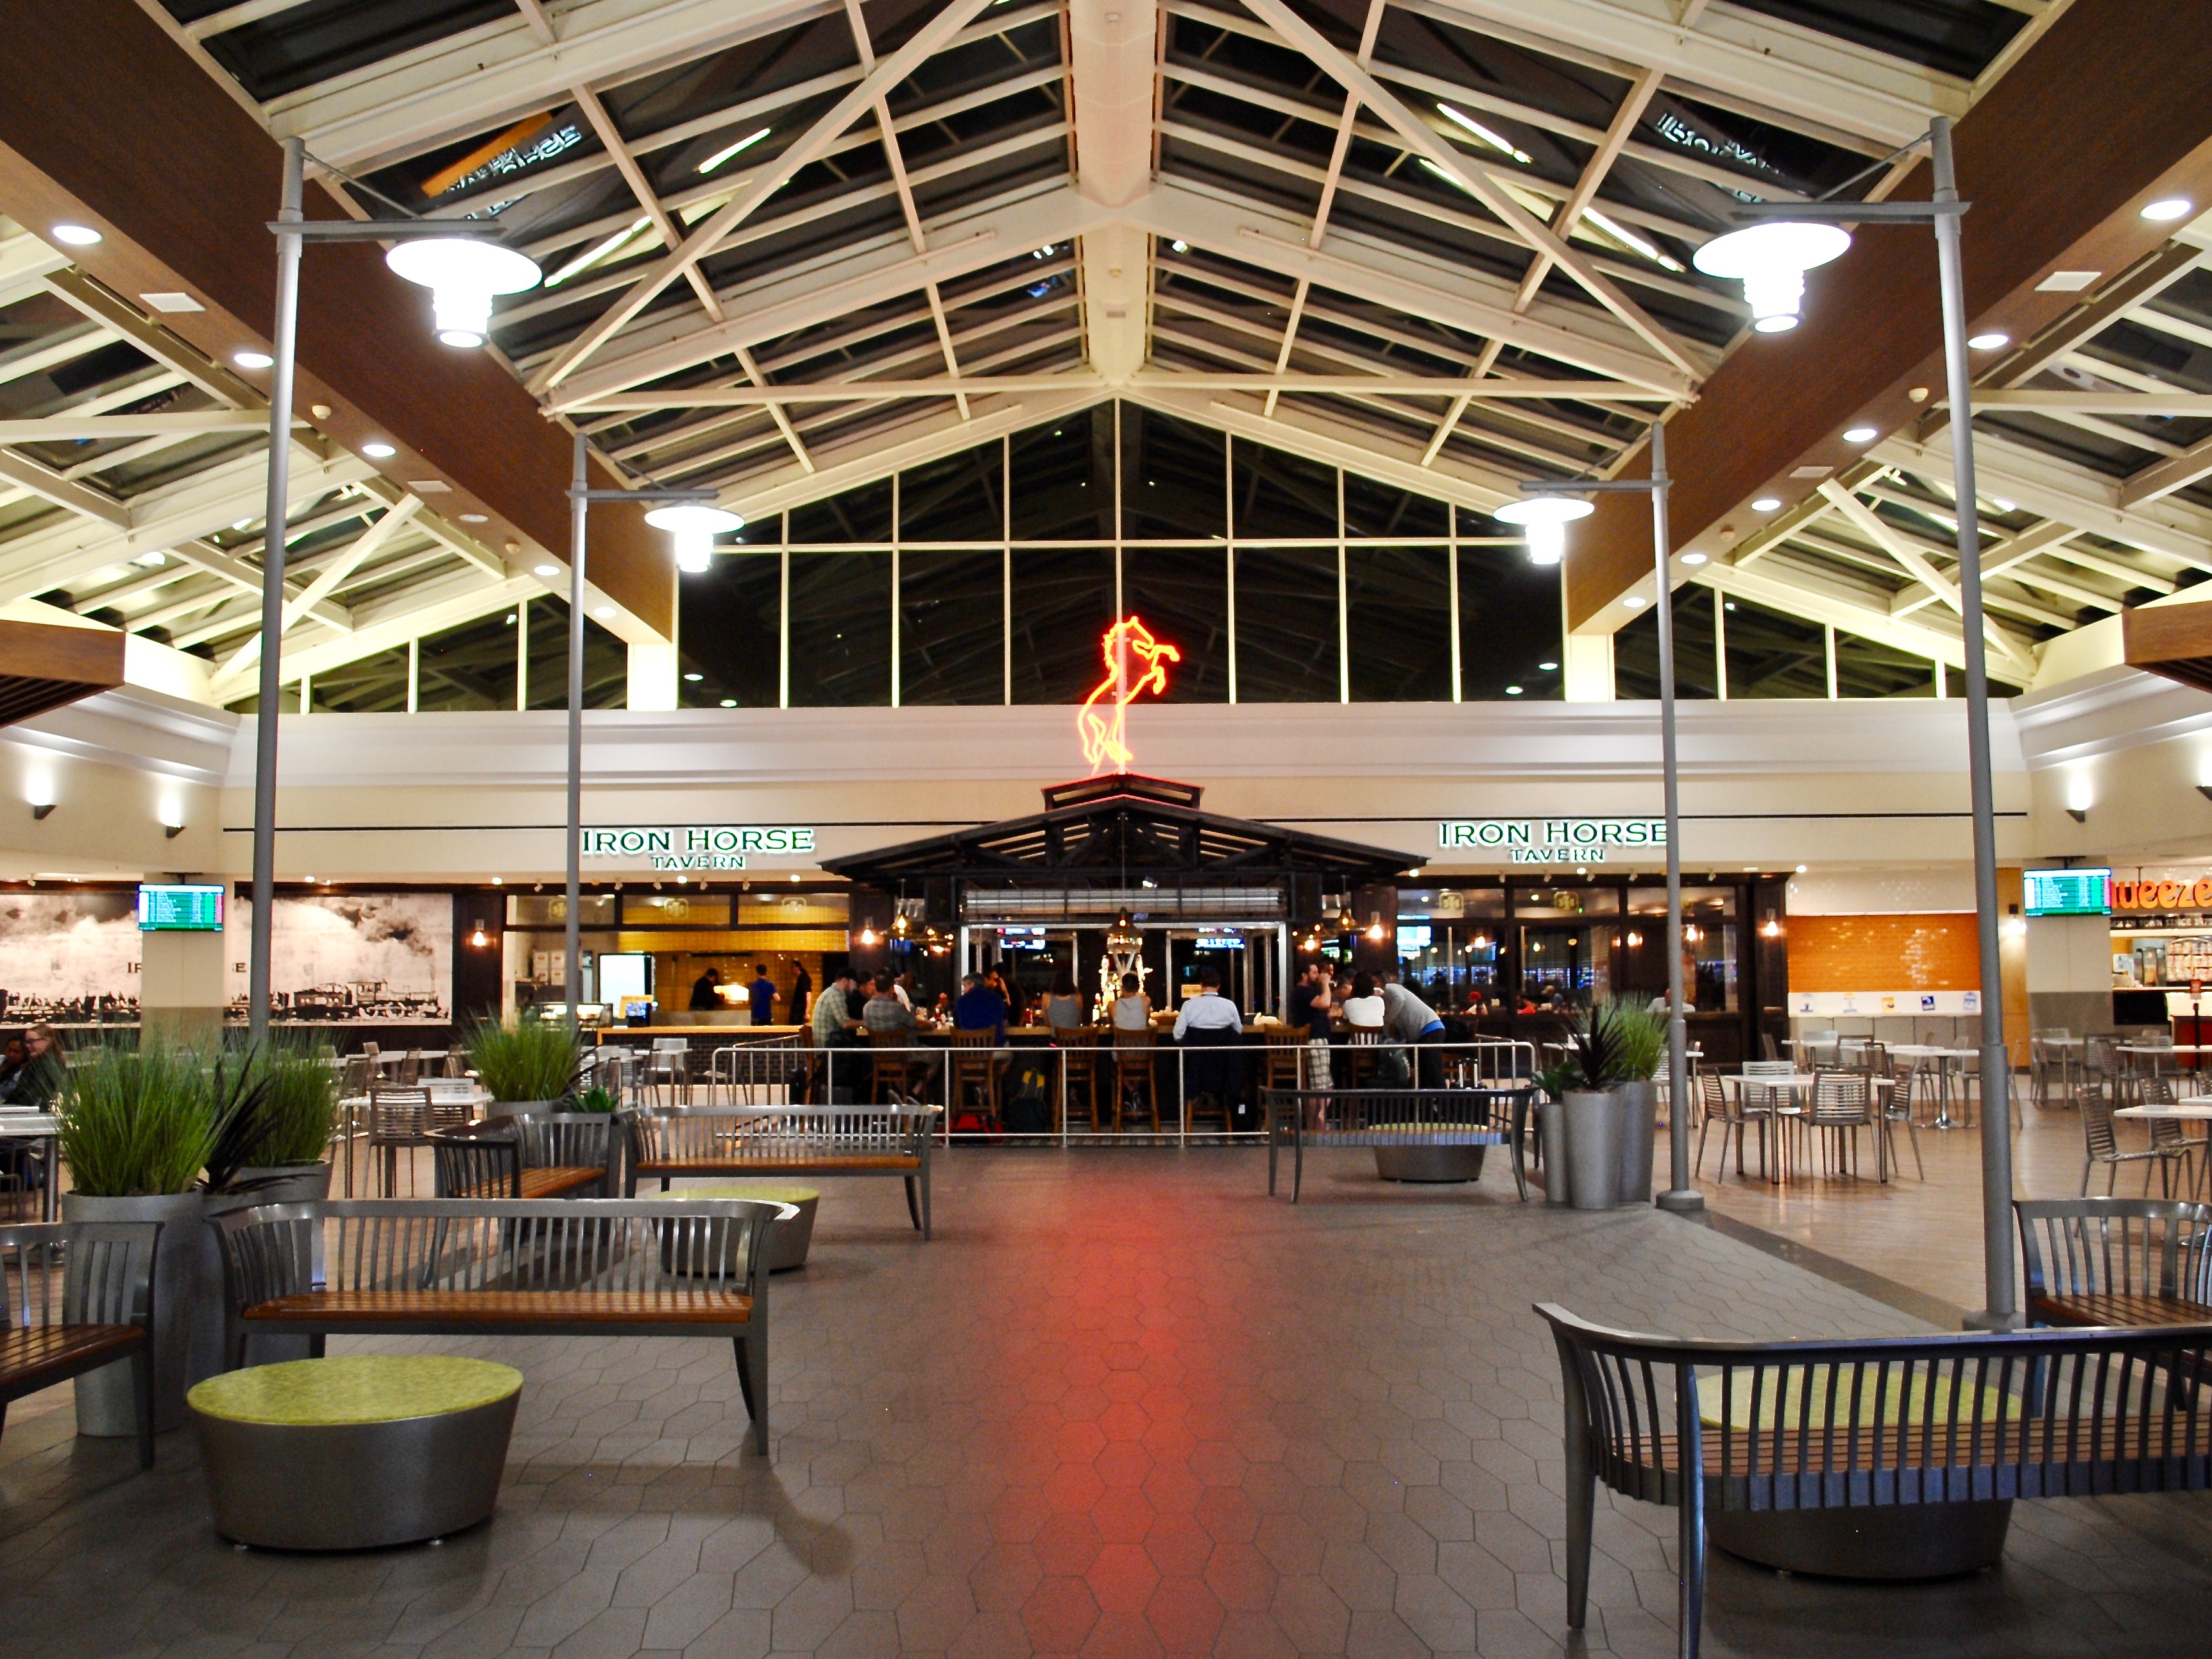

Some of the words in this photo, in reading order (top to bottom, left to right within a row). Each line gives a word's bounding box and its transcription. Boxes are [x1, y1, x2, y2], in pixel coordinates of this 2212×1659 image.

[582, 830, 670, 852] IRON
[686, 830, 813, 851] HORSE
[1442, 822, 1530, 846] IRON
[651, 856, 744, 869] TAVERN
[1510, 848, 1604, 862] TAVERN
